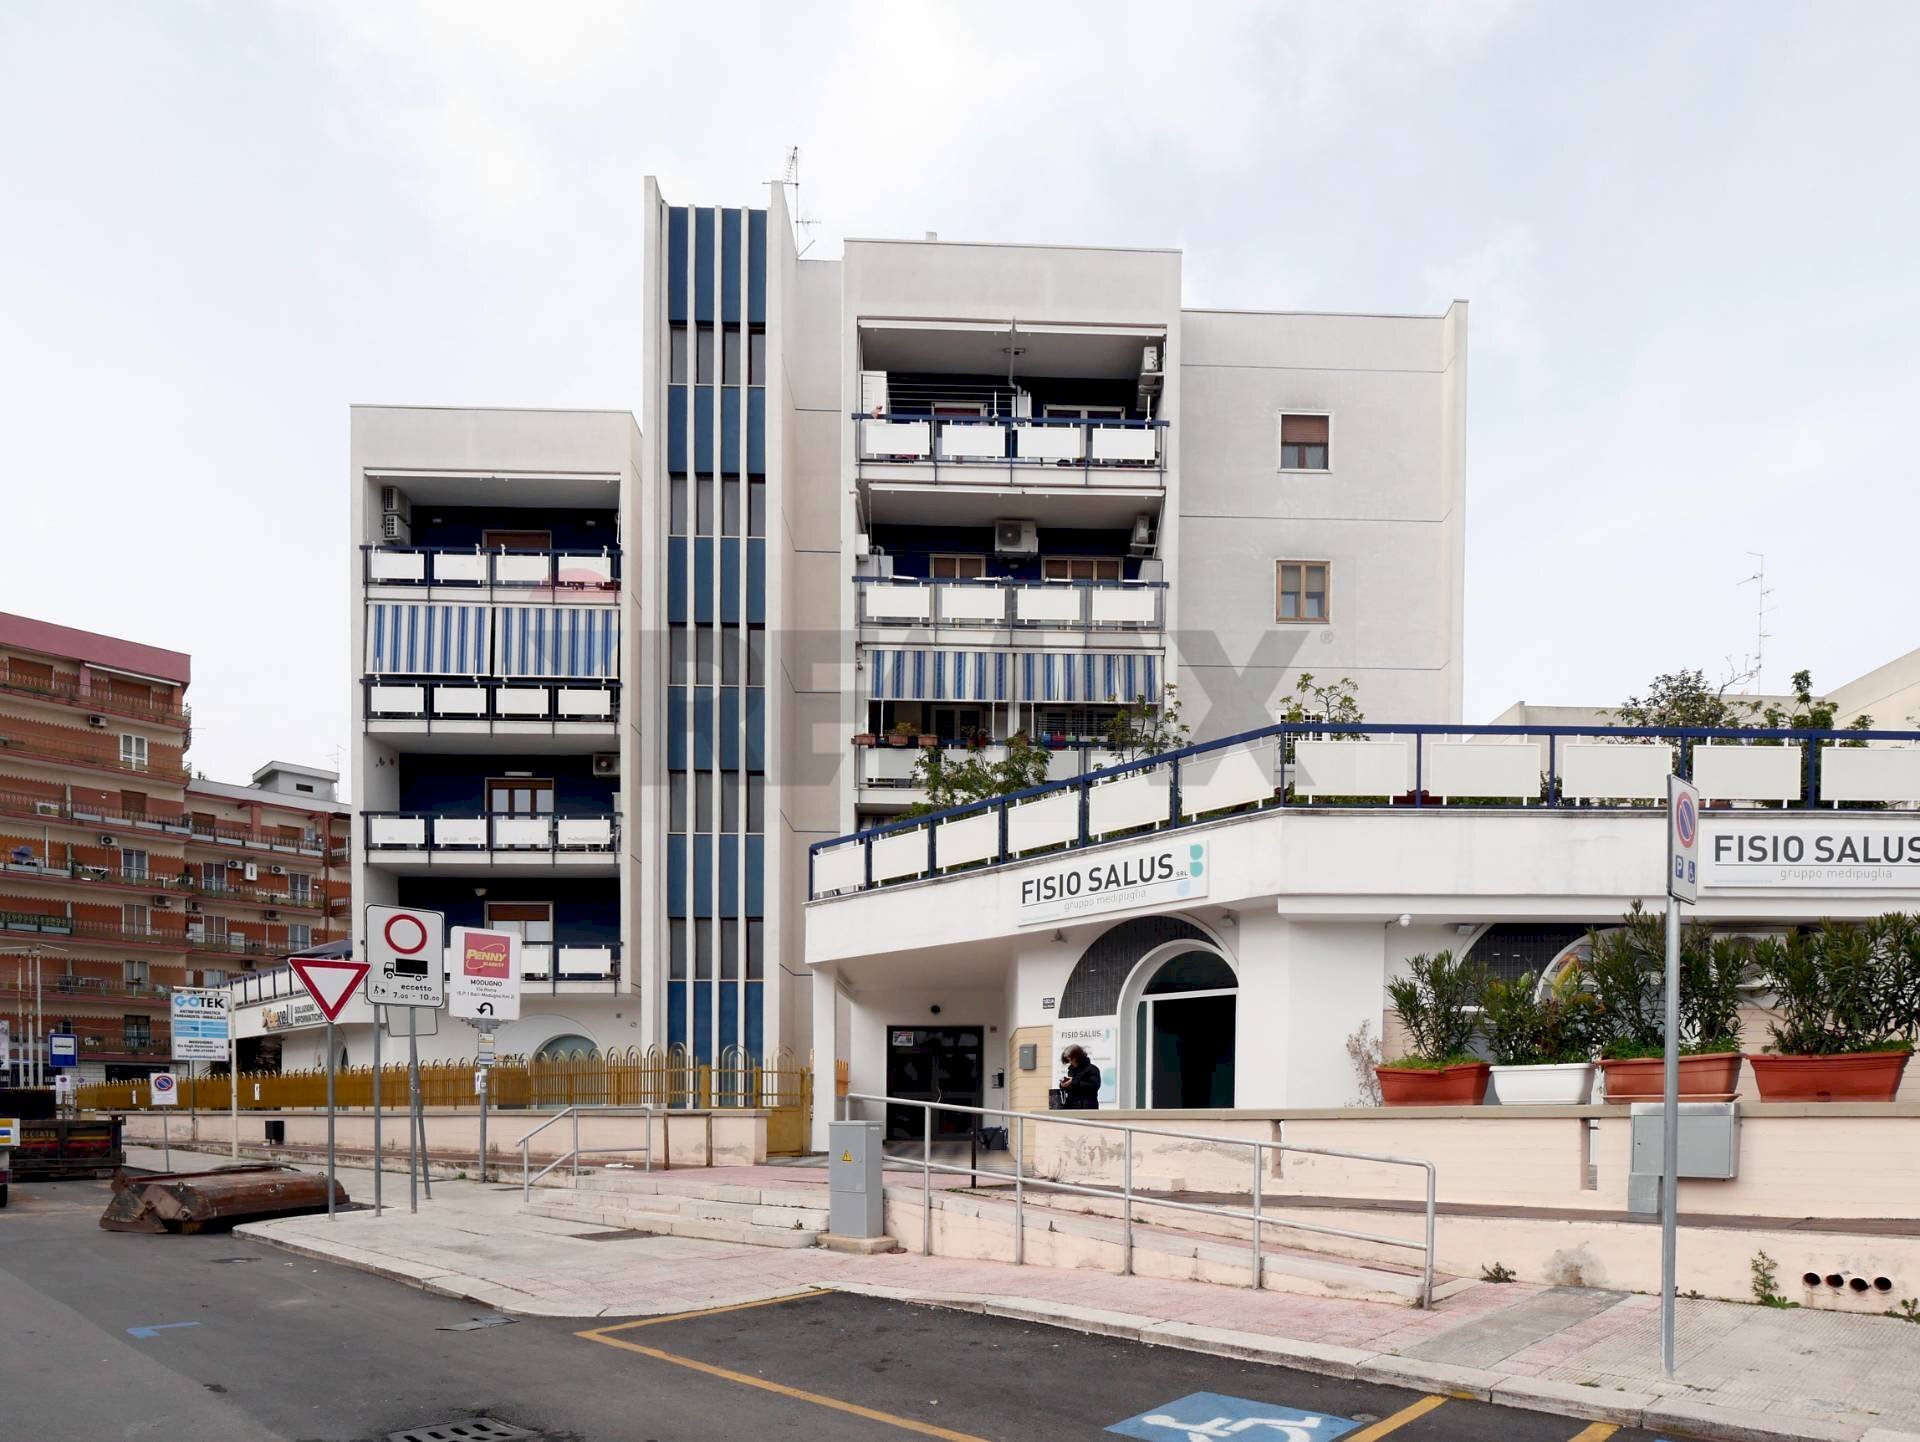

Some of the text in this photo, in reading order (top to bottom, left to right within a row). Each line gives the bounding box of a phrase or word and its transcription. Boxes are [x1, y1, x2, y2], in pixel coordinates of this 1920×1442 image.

[1714, 835, 1920, 863] FISIO SALUS
[1022, 871, 1081, 904] FISIO
[1088, 853, 1174, 892] SALUS
[1780, 868, 1893, 881] gruppo medipuglia
[1064, 888, 1147, 912] gruppo medipuglia
[466, 949, 506, 962] PENNY
[401, 984, 433, 992] eccetto
[175, 995, 225, 1009] GOTEK
[1061, 1030, 1102, 1039] FISIO SALUS
